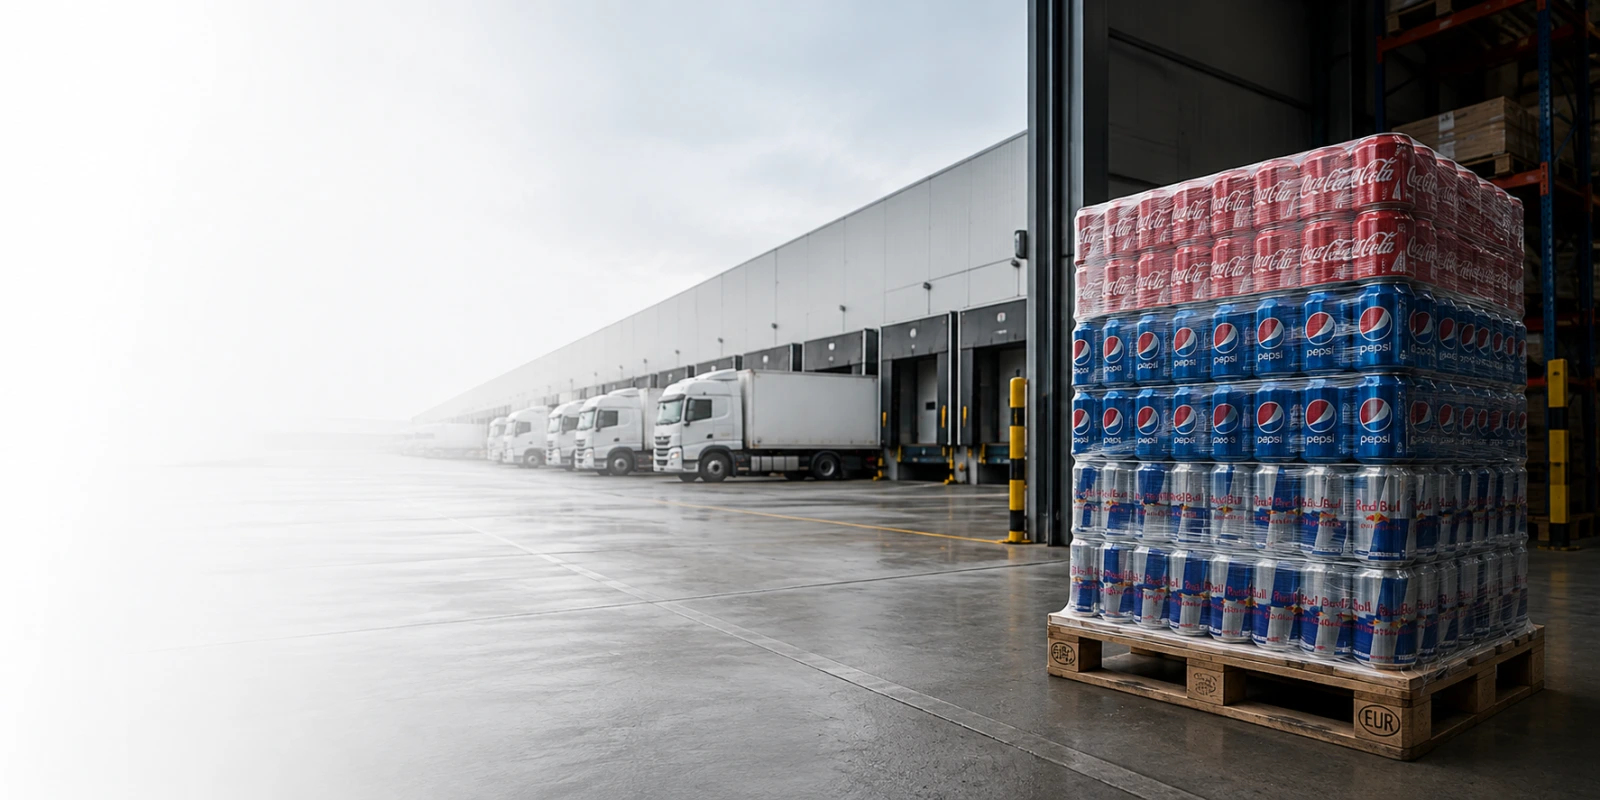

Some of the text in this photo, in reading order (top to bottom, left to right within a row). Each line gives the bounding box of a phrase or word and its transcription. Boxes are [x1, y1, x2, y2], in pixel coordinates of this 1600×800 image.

[1306, 346, 1335, 359] pepsi
[1359, 342, 1392, 356] pepsi
[1213, 354, 1238, 365] pepsi
[1257, 350, 1284, 362] pepsi
[1257, 434, 1283, 445] pepsi
[1306, 433, 1335, 446] pepsi
[1360, 433, 1391, 446] pepsi
[1364, 709, 1394, 733] EUR
